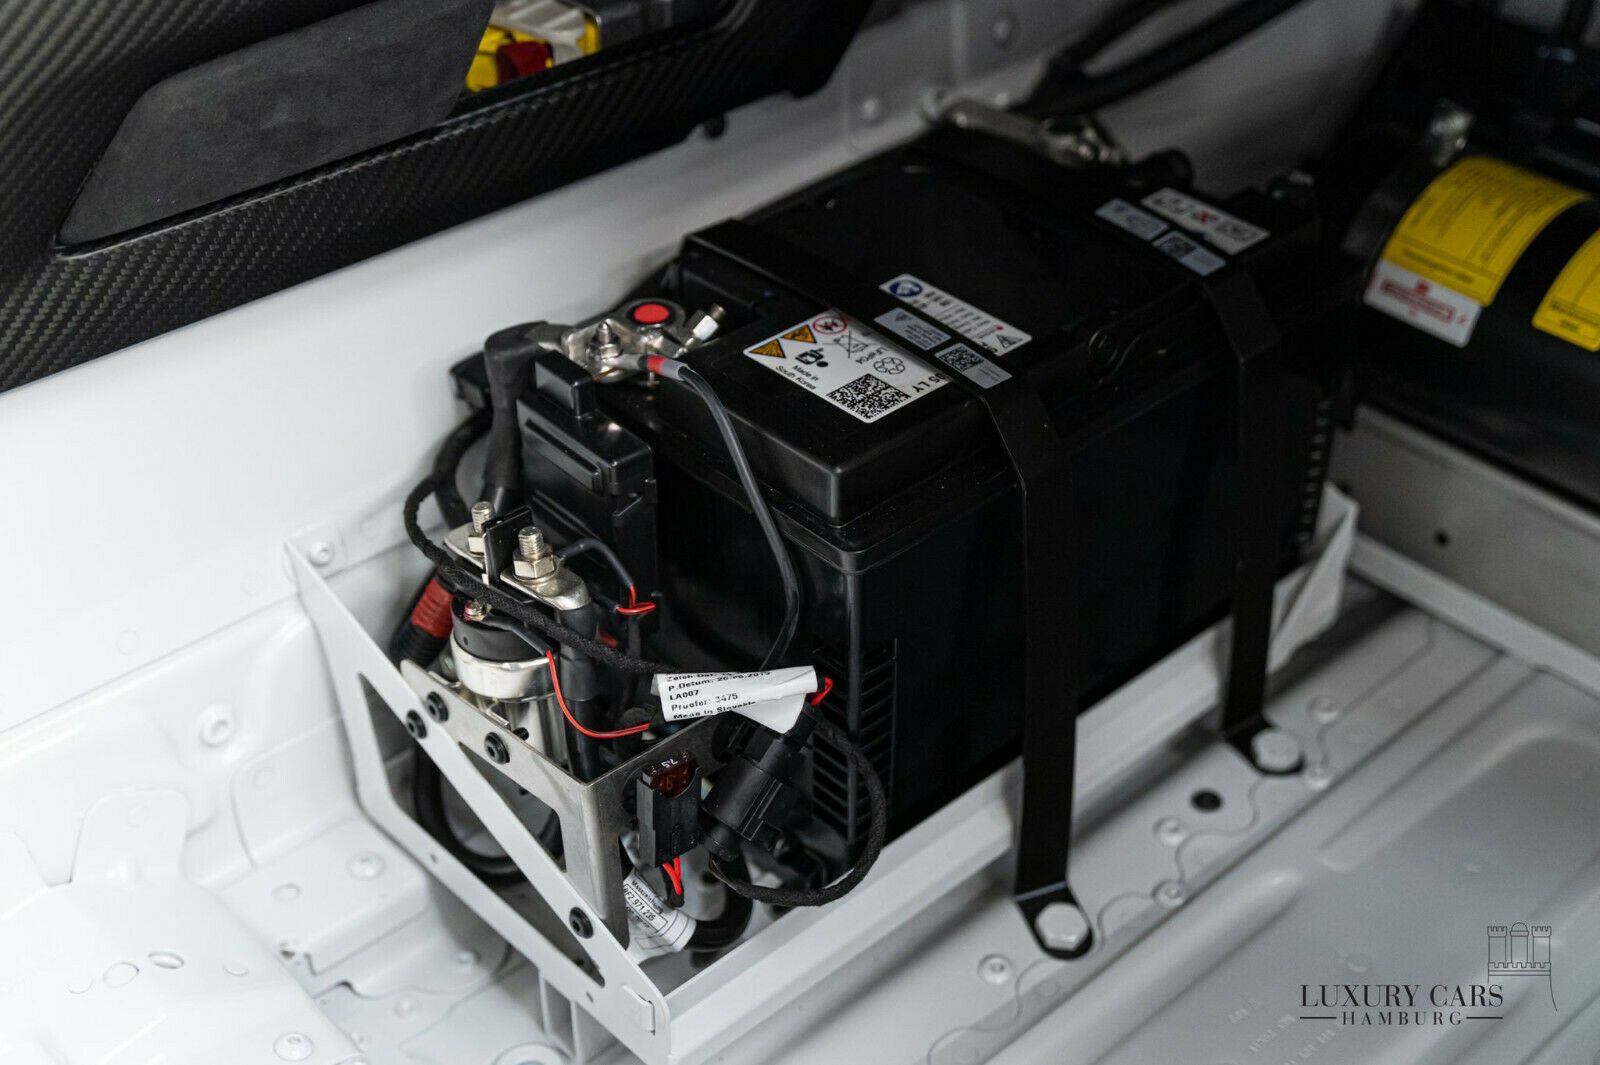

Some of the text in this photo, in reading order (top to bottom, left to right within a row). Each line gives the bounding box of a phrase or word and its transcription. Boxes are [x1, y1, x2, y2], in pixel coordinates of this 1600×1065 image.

[792, 364, 812, 377] Made
[776, 365, 817, 390] South Korea
[912, 380, 930, 393] LY
[669, 690, 700, 701] LA007
[671, 699, 712, 711] Pruefer:
[661, 758, 679, 768] 7.5
